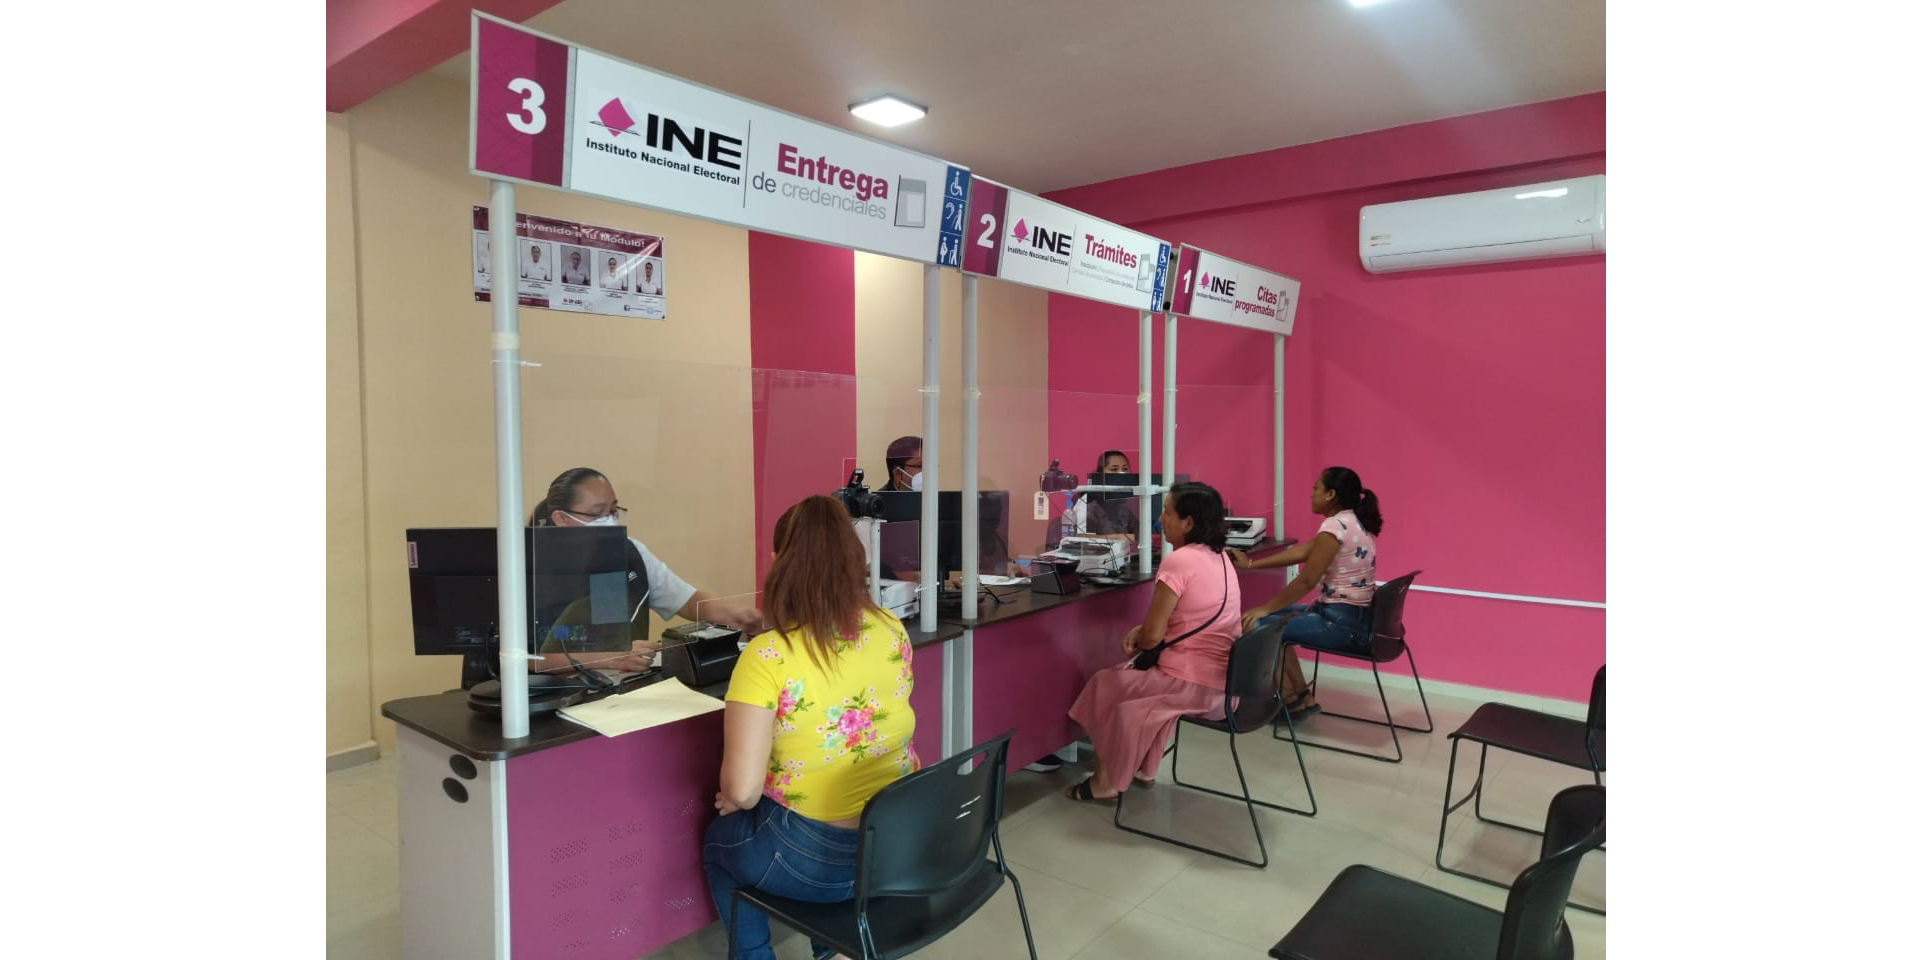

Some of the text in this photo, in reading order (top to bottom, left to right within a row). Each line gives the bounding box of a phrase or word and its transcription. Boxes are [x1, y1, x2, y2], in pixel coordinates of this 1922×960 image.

[506, 77, 547, 135] 3
[646, 113, 742, 170] INE
[586, 138, 740, 185] Instituto Nacional Electoral
[777, 142, 888, 201] Entrega
[752, 171, 887, 220] de credenciales
[516, 221, 571, 236] envenido
[977, 213, 996, 249] 2
[1032, 225, 1072, 256] INE
[1085, 233, 1137, 269] Trámites
[1183, 269, 1192, 294] 1
[1210, 275, 1236, 297] INE
[1257, 285, 1278, 305] Citas
[1235, 299, 1275, 317] programadas
